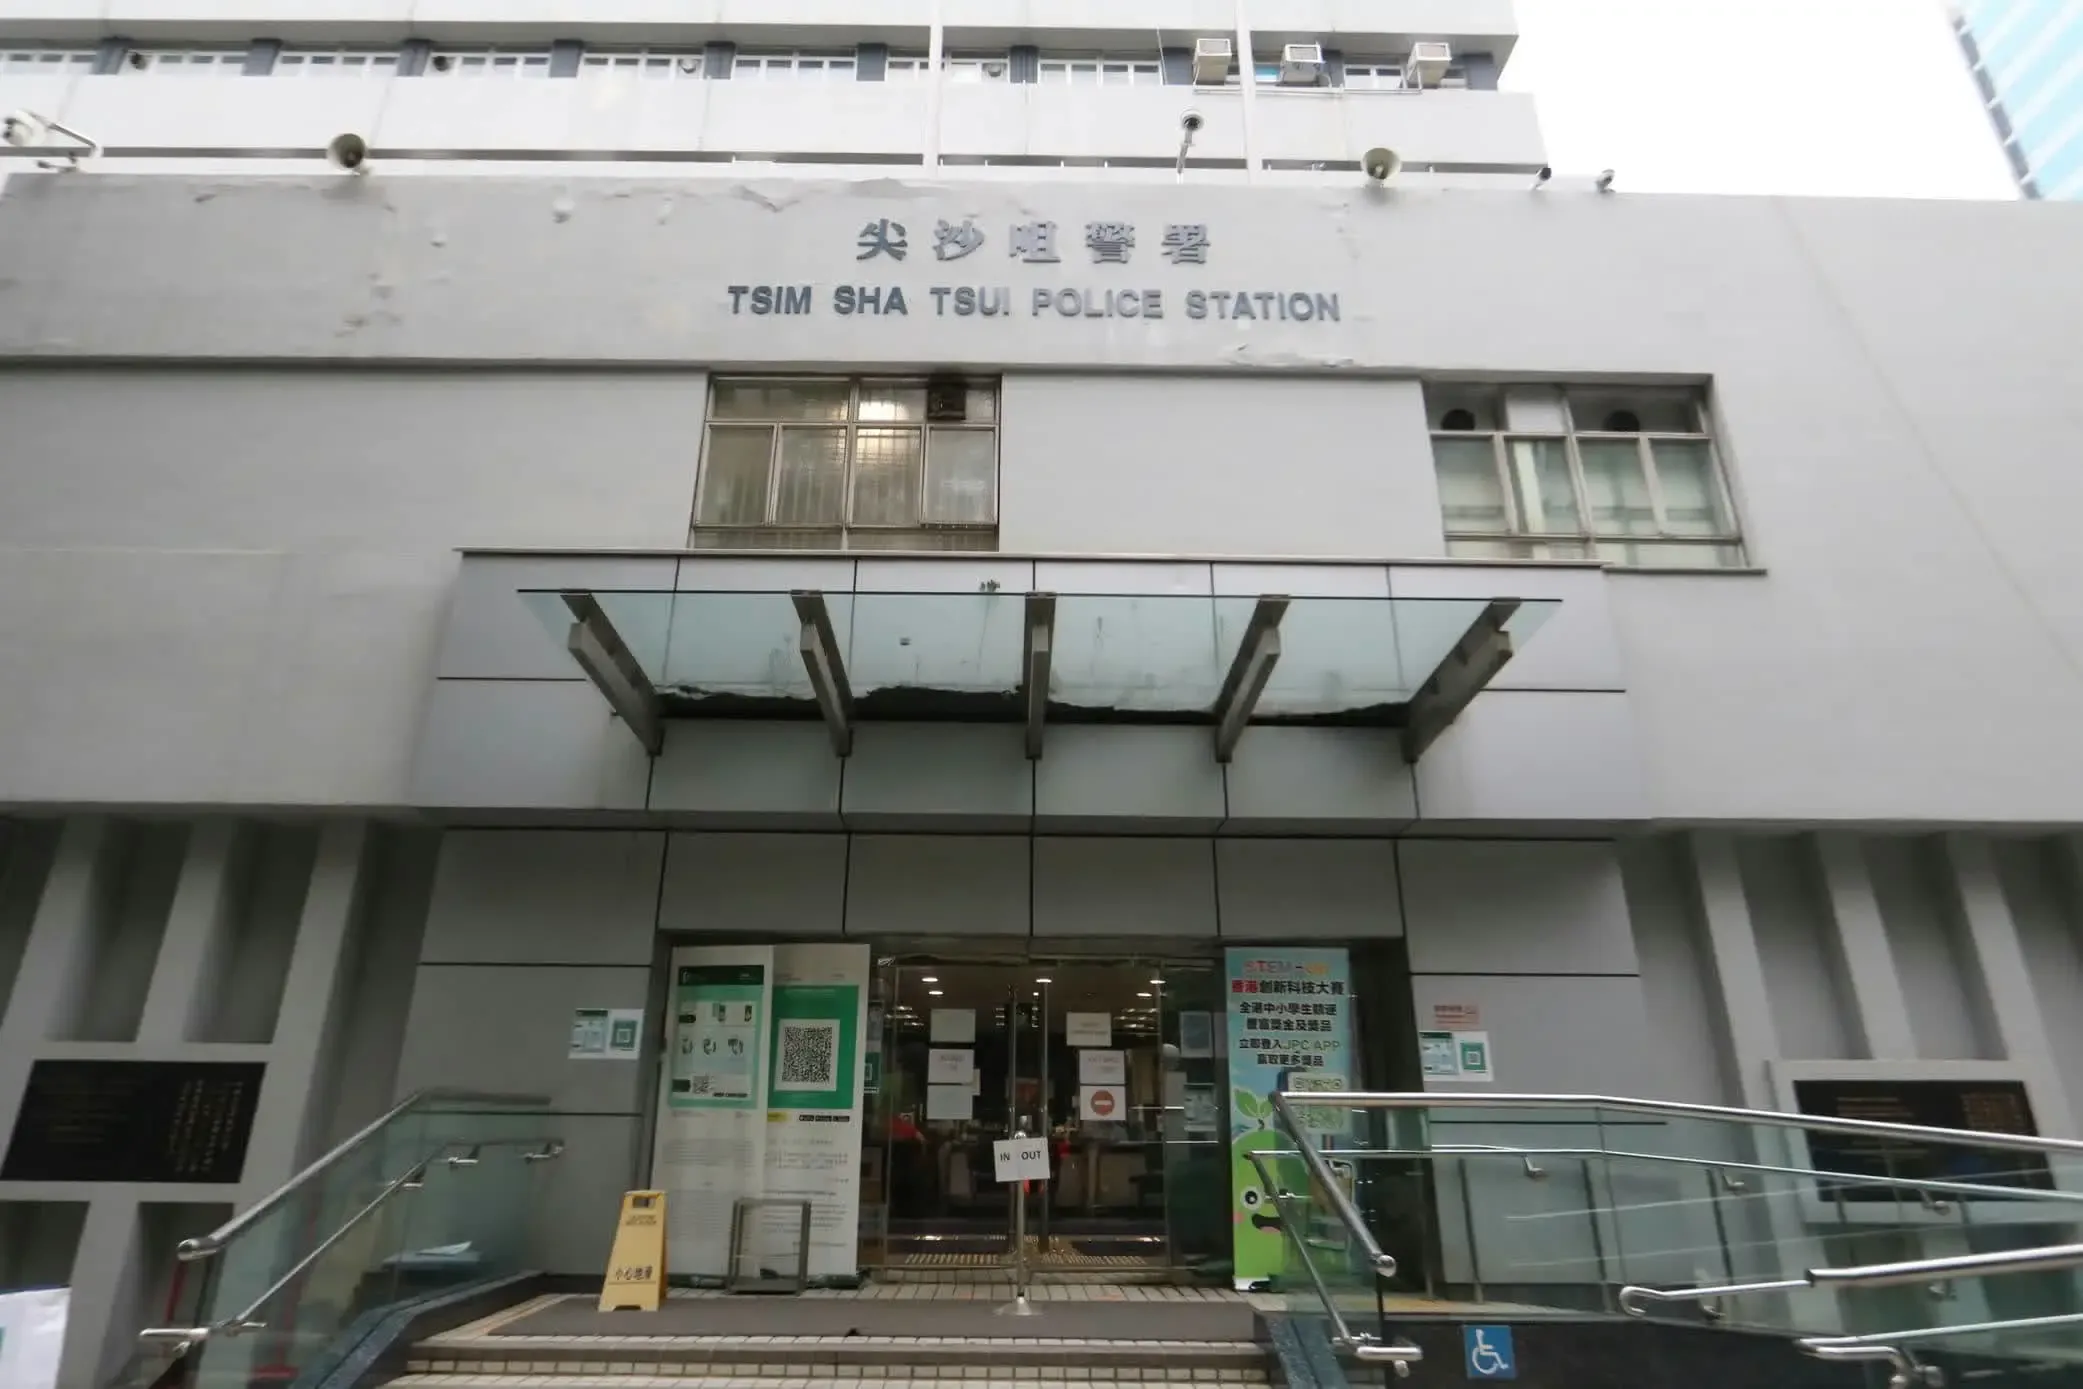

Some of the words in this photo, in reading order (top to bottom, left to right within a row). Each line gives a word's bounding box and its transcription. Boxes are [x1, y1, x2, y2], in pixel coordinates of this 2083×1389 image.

[856, 218, 1211, 264] 尖沙咀警署
[728, 286, 812, 315] TSIM
[833, 285, 908, 316] SHA
[930, 286, 1010, 318] TSUI
[1032, 288, 1165, 319] POLICE
[1185, 290, 1341, 322] STATION
[1000, 1152, 1010, 1161] IN
[1021, 1151, 1041, 1160] OUT
